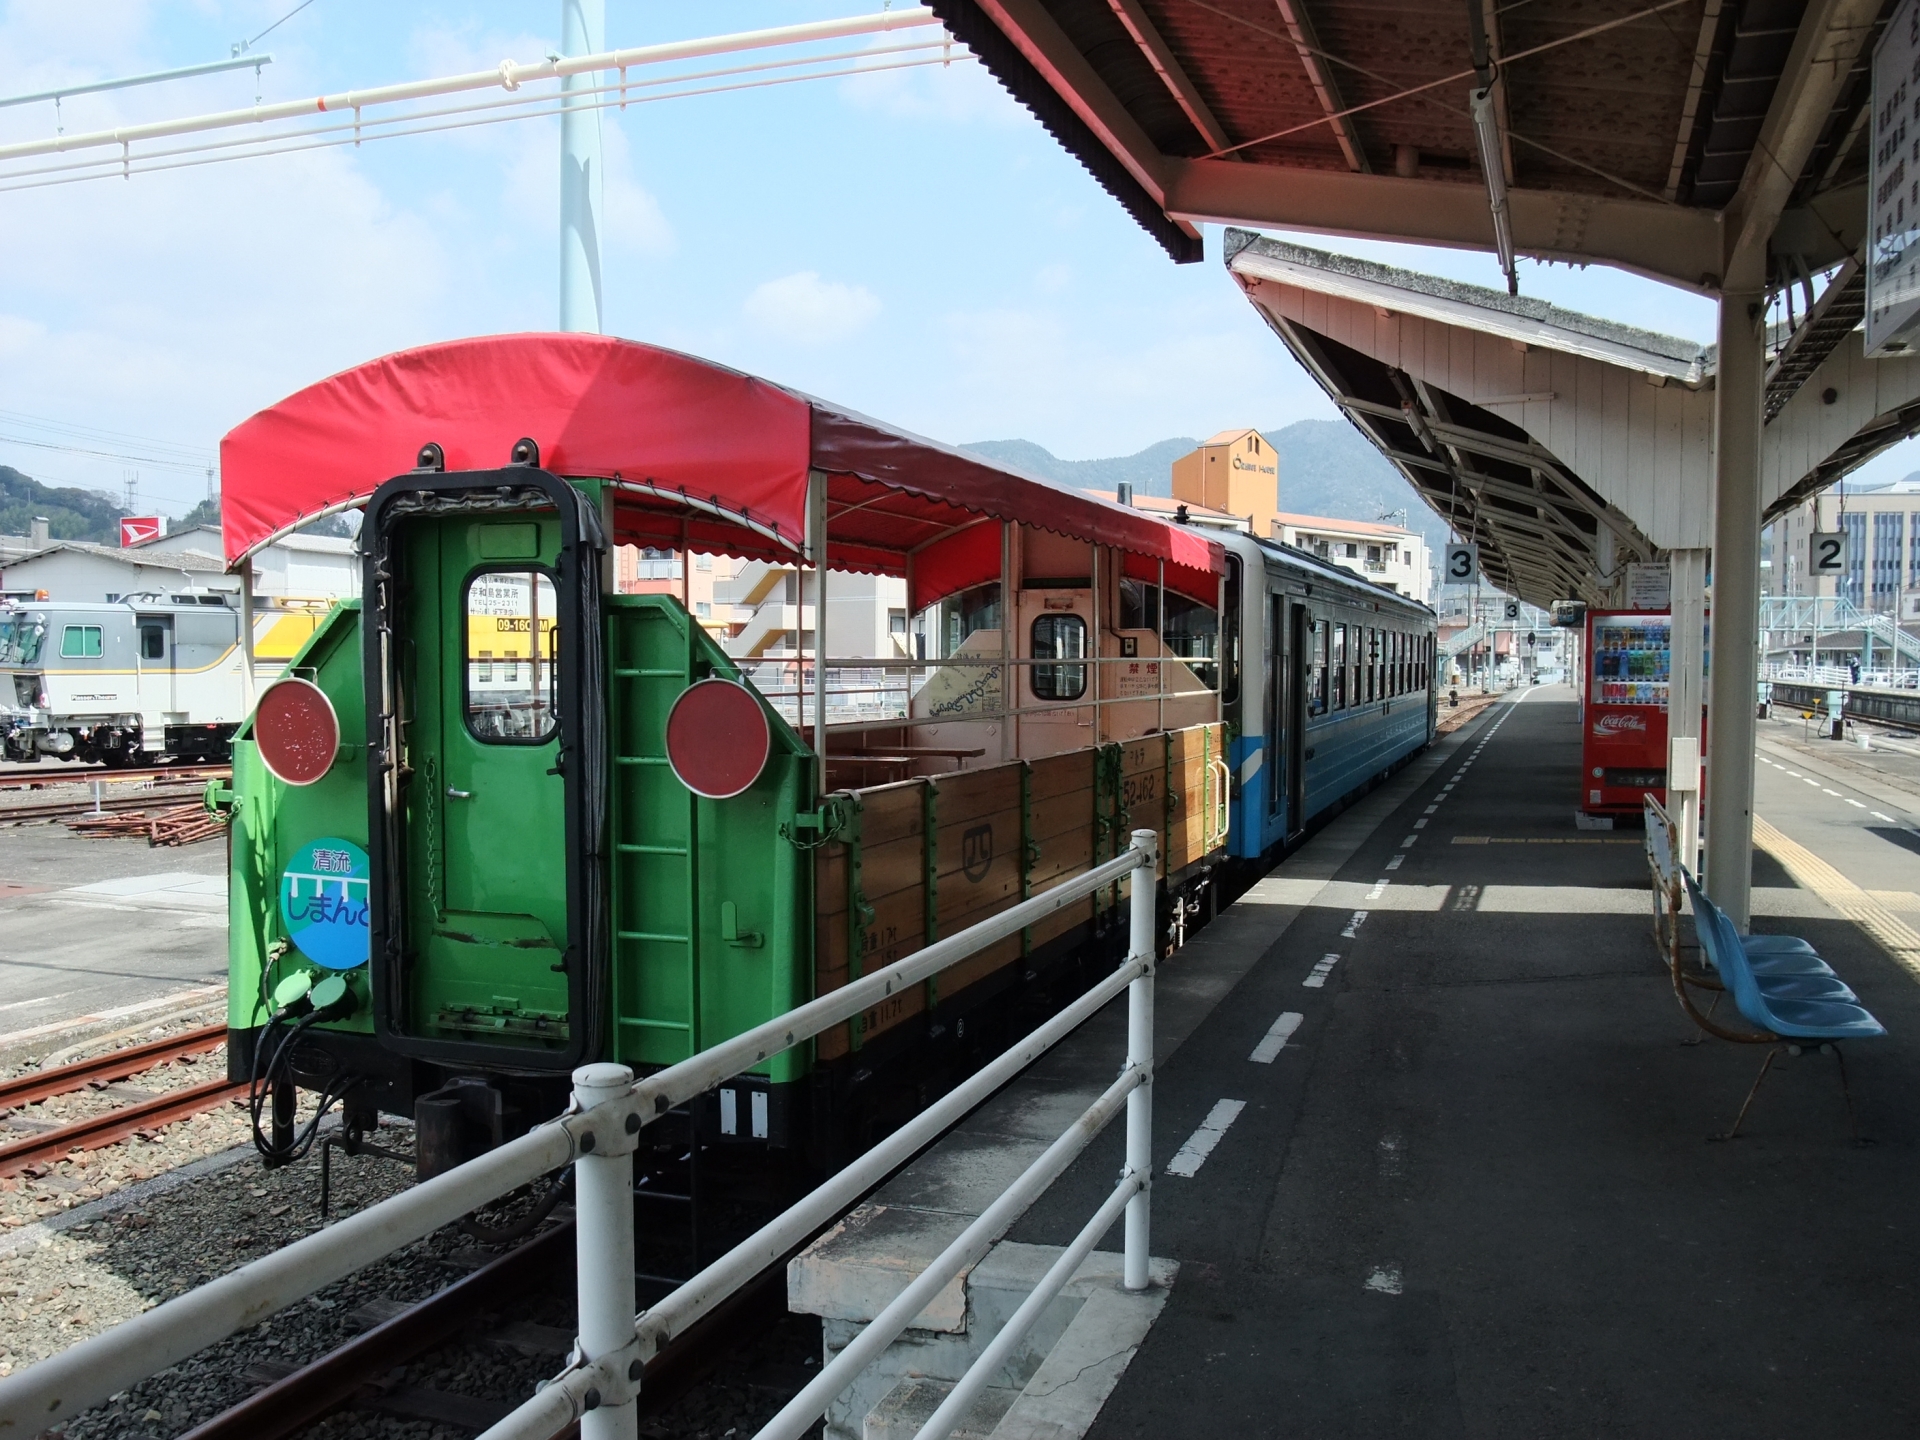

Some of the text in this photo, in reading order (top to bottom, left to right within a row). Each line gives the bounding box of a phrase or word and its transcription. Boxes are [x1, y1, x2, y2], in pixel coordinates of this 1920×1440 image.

[1819, 539, 1841, 569] 2
[1451, 550, 1471, 578] 3
[470, 587, 518, 599] 宇和島営業所
[1507, 604, 1518, 618] 3
[498, 619, 548, 631] 09-16CM
[1128, 662, 1158, 675] 禁煙
[1600, 714, 1640, 729] Coca-Cola
[312, 848, 351, 873] 清流
